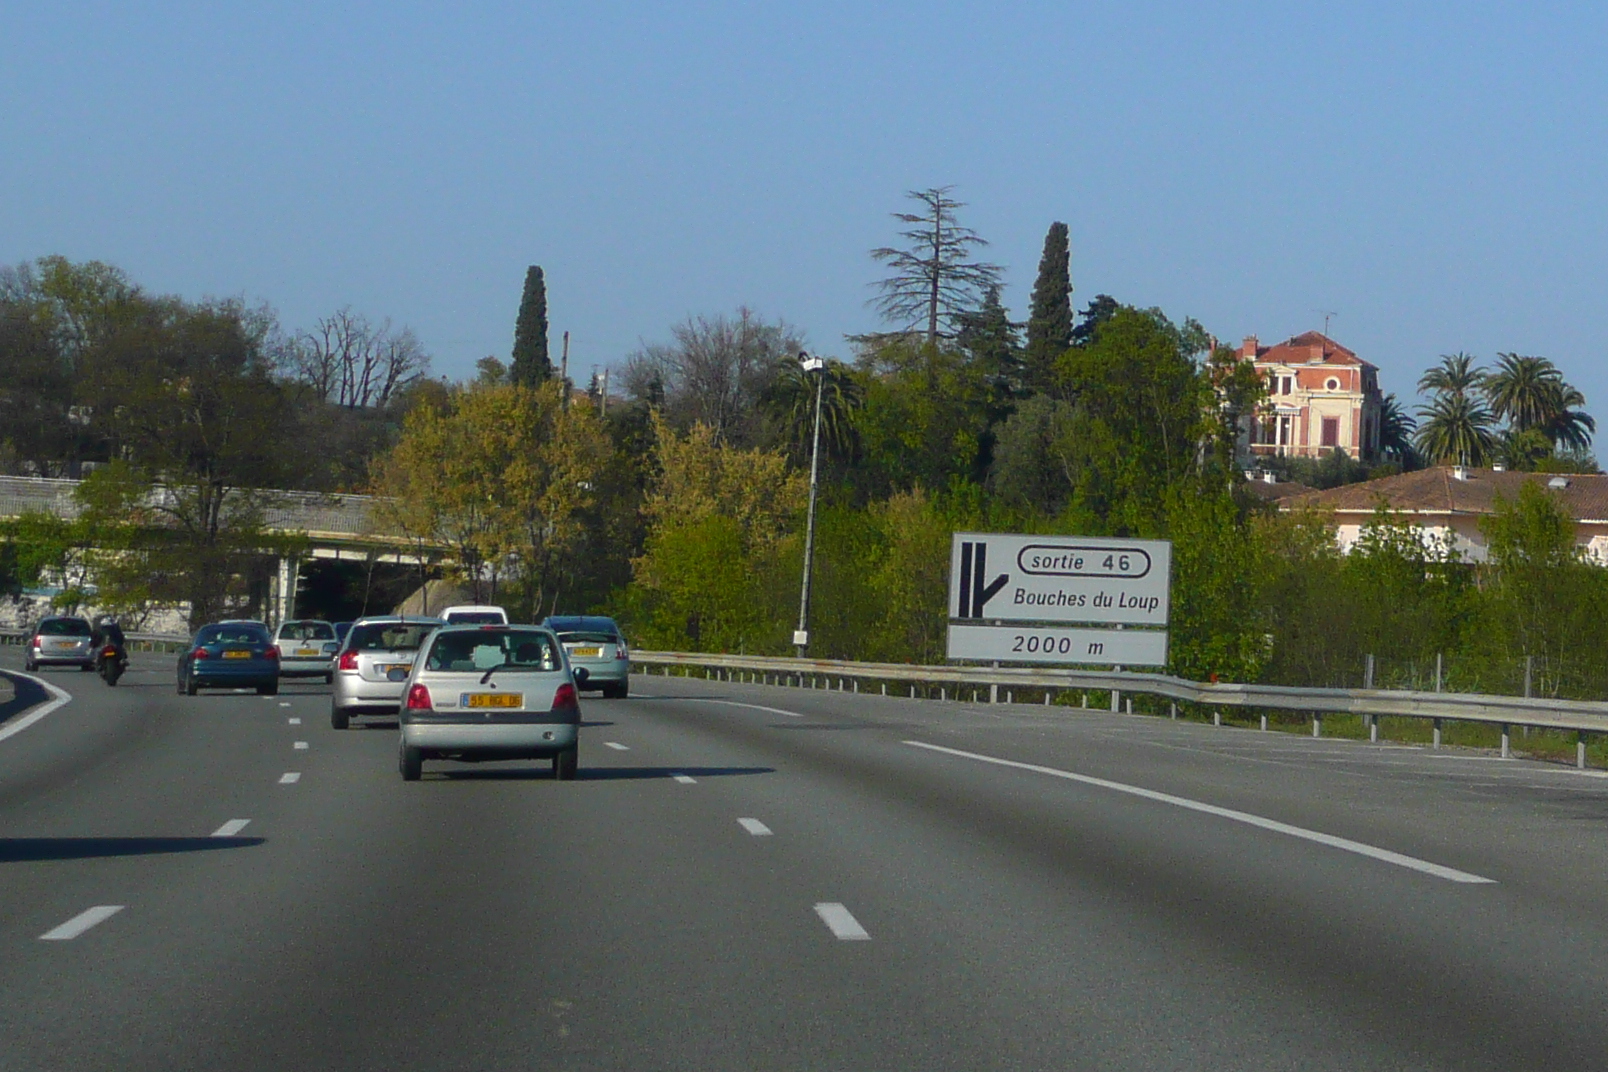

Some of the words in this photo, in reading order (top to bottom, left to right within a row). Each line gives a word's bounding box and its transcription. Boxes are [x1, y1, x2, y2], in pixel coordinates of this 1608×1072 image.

[1031, 553, 1084, 570] sortie
[1102, 554, 1131, 572] 46
[1013, 588, 1087, 608] Bouches
[1092, 590, 1114, 609] du
[1118, 591, 1160, 614] Loup
[1012, 635, 1072, 655] 2000
[1087, 641, 1105, 656] m
